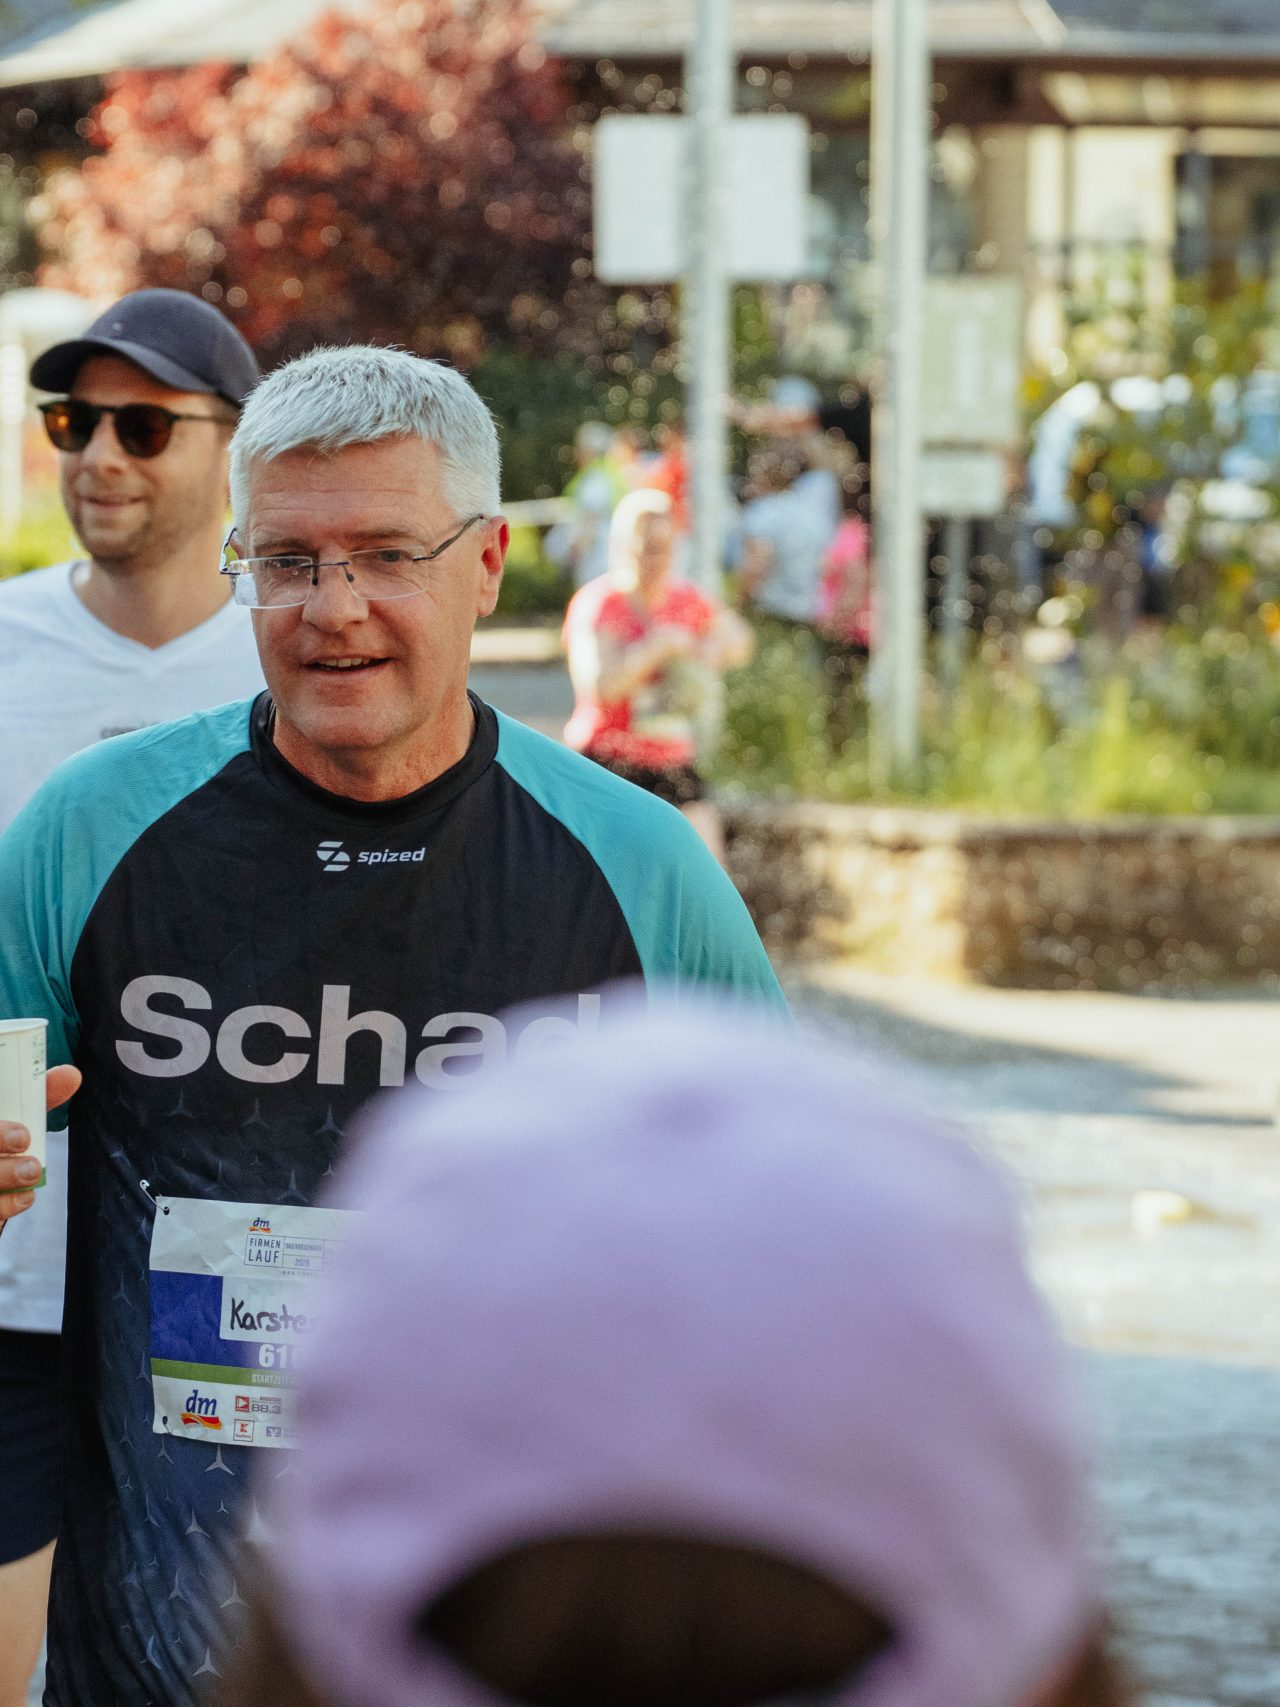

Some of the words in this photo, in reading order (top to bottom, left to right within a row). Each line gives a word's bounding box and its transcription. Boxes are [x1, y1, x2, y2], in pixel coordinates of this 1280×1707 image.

[357, 847, 426, 865] spized
[252, 1217, 270, 1228] dm
[249, 1238, 281, 1249] FIRMEN
[248, 1249, 280, 1263] LAUF
[230, 1297, 319, 1334] Karste
[185, 1389, 218, 1416] dm
[251, 1403, 282, 1414] 88.3
